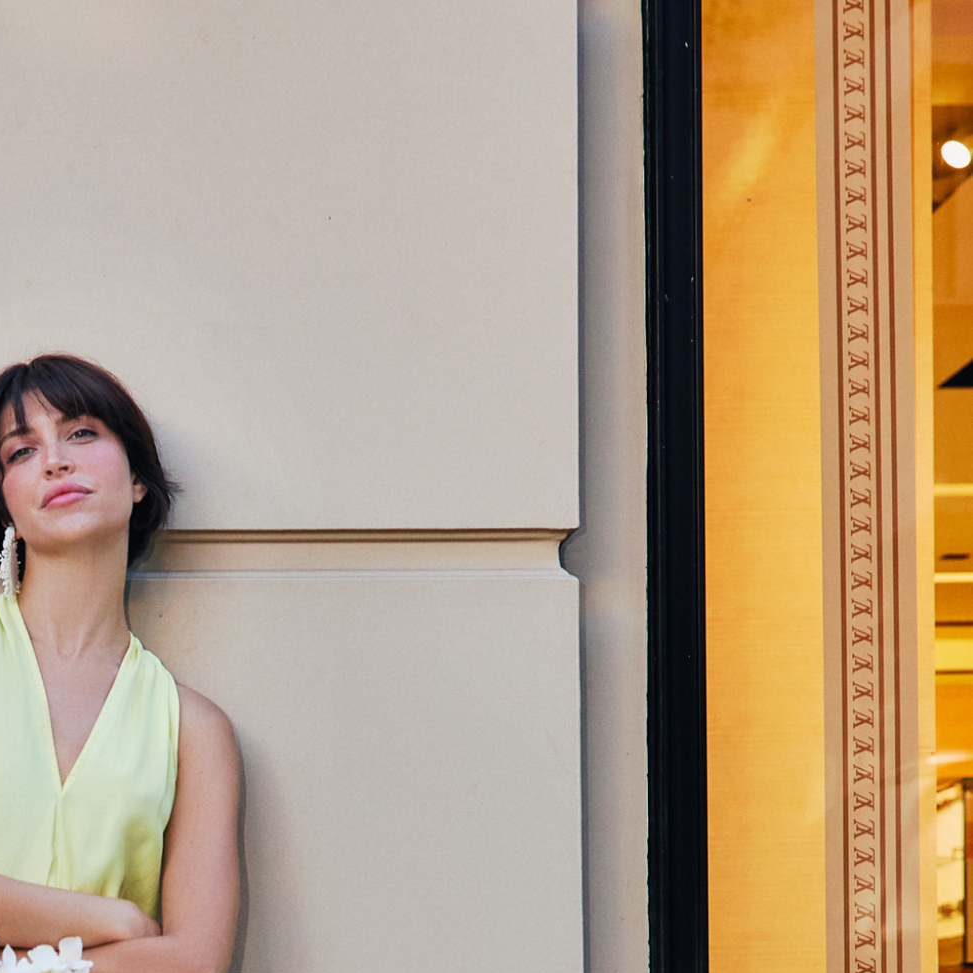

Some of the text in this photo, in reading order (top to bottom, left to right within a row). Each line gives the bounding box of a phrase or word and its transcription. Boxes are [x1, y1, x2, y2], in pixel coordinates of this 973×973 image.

[843, 21, 865, 42] LV
[843, 49, 865, 69] LV
[843, 76, 865, 96] LV
[844, 103, 866, 124] LV
[844, 131, 866, 151] LV
[844, 158, 866, 179] LV
[845, 186, 867, 206] LV
[845, 213, 867, 234] LV
[846, 241, 868, 261] LV
[846, 268, 868, 288] LV
[847, 295, 869, 316] LV
[847, 323, 869, 344] LV
[848, 350, 870, 371] LV
[848, 378, 870, 399] LV
[849, 405, 870, 426] LV
[849, 433, 871, 454] LV
[850, 460, 871, 481] LV
[850, 488, 871, 509] LV
[850, 515, 872, 536] LV
[851, 543, 872, 564] LV
[851, 571, 873, 591] LV
[851, 598, 873, 619] LV
[852, 625, 873, 646] LV
[852, 653, 873, 674] LV
[852, 681, 874, 701] LV
[853, 708, 874, 729] LV
[853, 736, 874, 757] LV
[853, 764, 875, 784] LV
[853, 791, 875, 812] LV
[853, 819, 875, 840] LV
[854, 846, 875, 867] LV
[854, 874, 875, 895] LV
[855, 902, 876, 922] LV
[855, 930, 875, 951] LV
